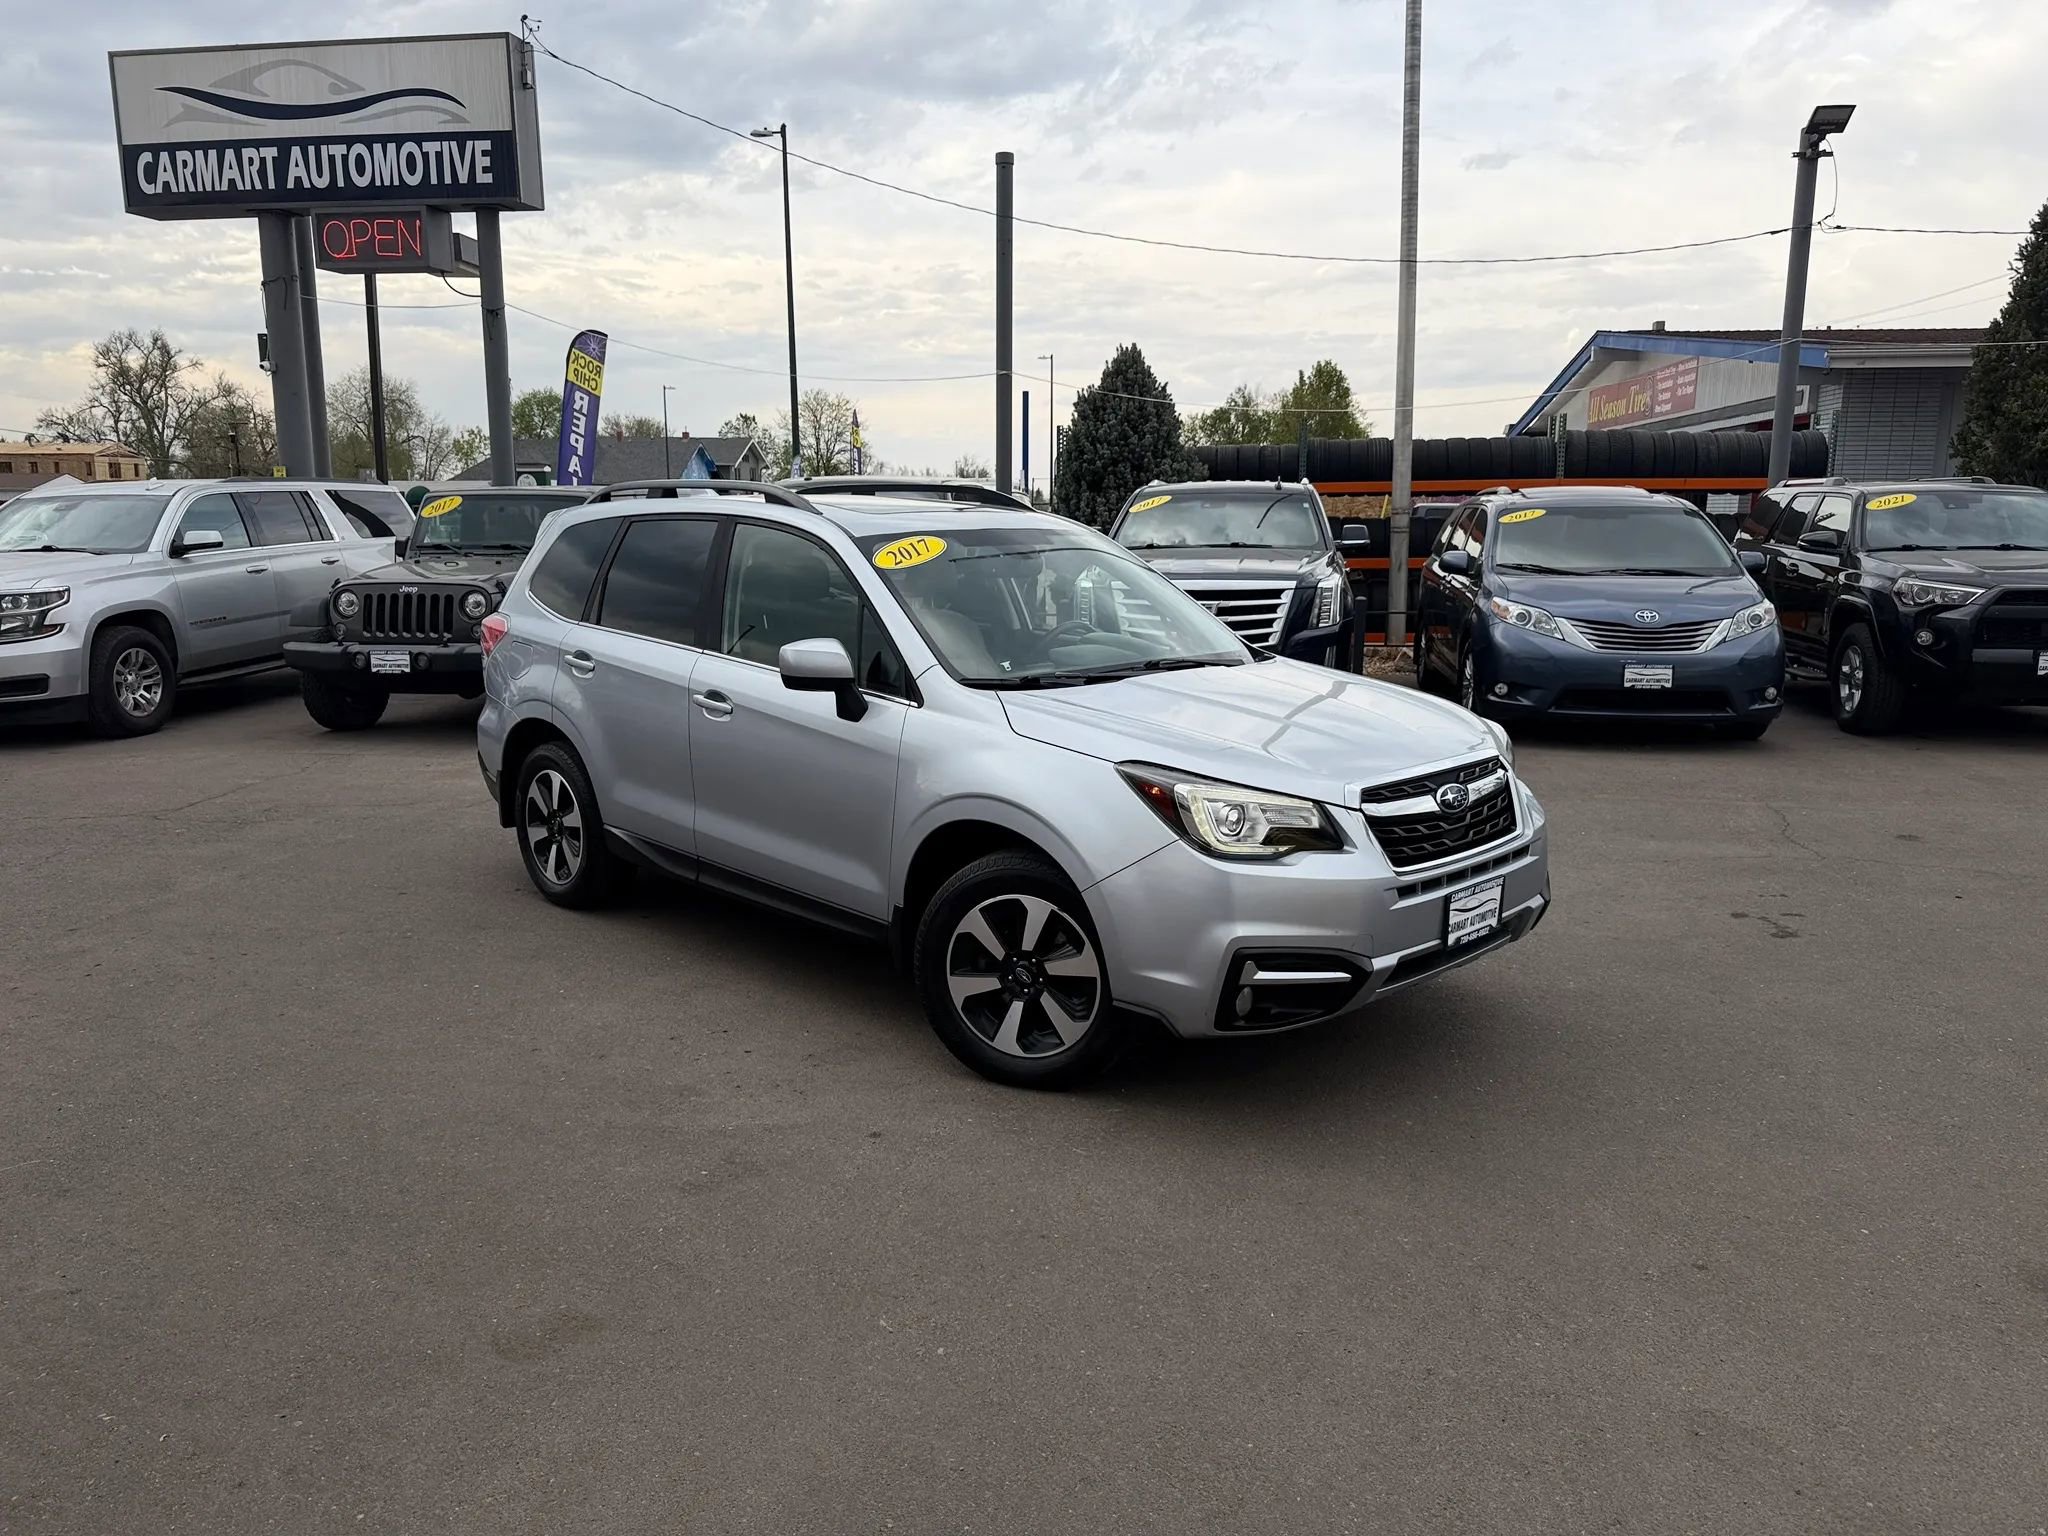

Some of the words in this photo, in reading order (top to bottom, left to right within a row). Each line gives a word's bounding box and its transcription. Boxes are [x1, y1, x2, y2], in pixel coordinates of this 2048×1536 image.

[137, 146, 278, 195] CARMART
[286, 140, 494, 189] AUTOMOTIVE
[323, 219, 422, 258] OPEN
[1600, 395, 1627, 421] Season
[428, 497, 455, 516] 2017
[1875, 494, 1905, 509] 2021
[1508, 510, 1536, 522] 2017
[886, 538, 930, 567] 2017
[399, 585, 418, 594] Jeep
[1451, 887, 1475, 902] CARMART
[1474, 876, 1505, 894] AUTOMOTIVE
[1470, 906, 1498, 926] AUTOMOTIVE
